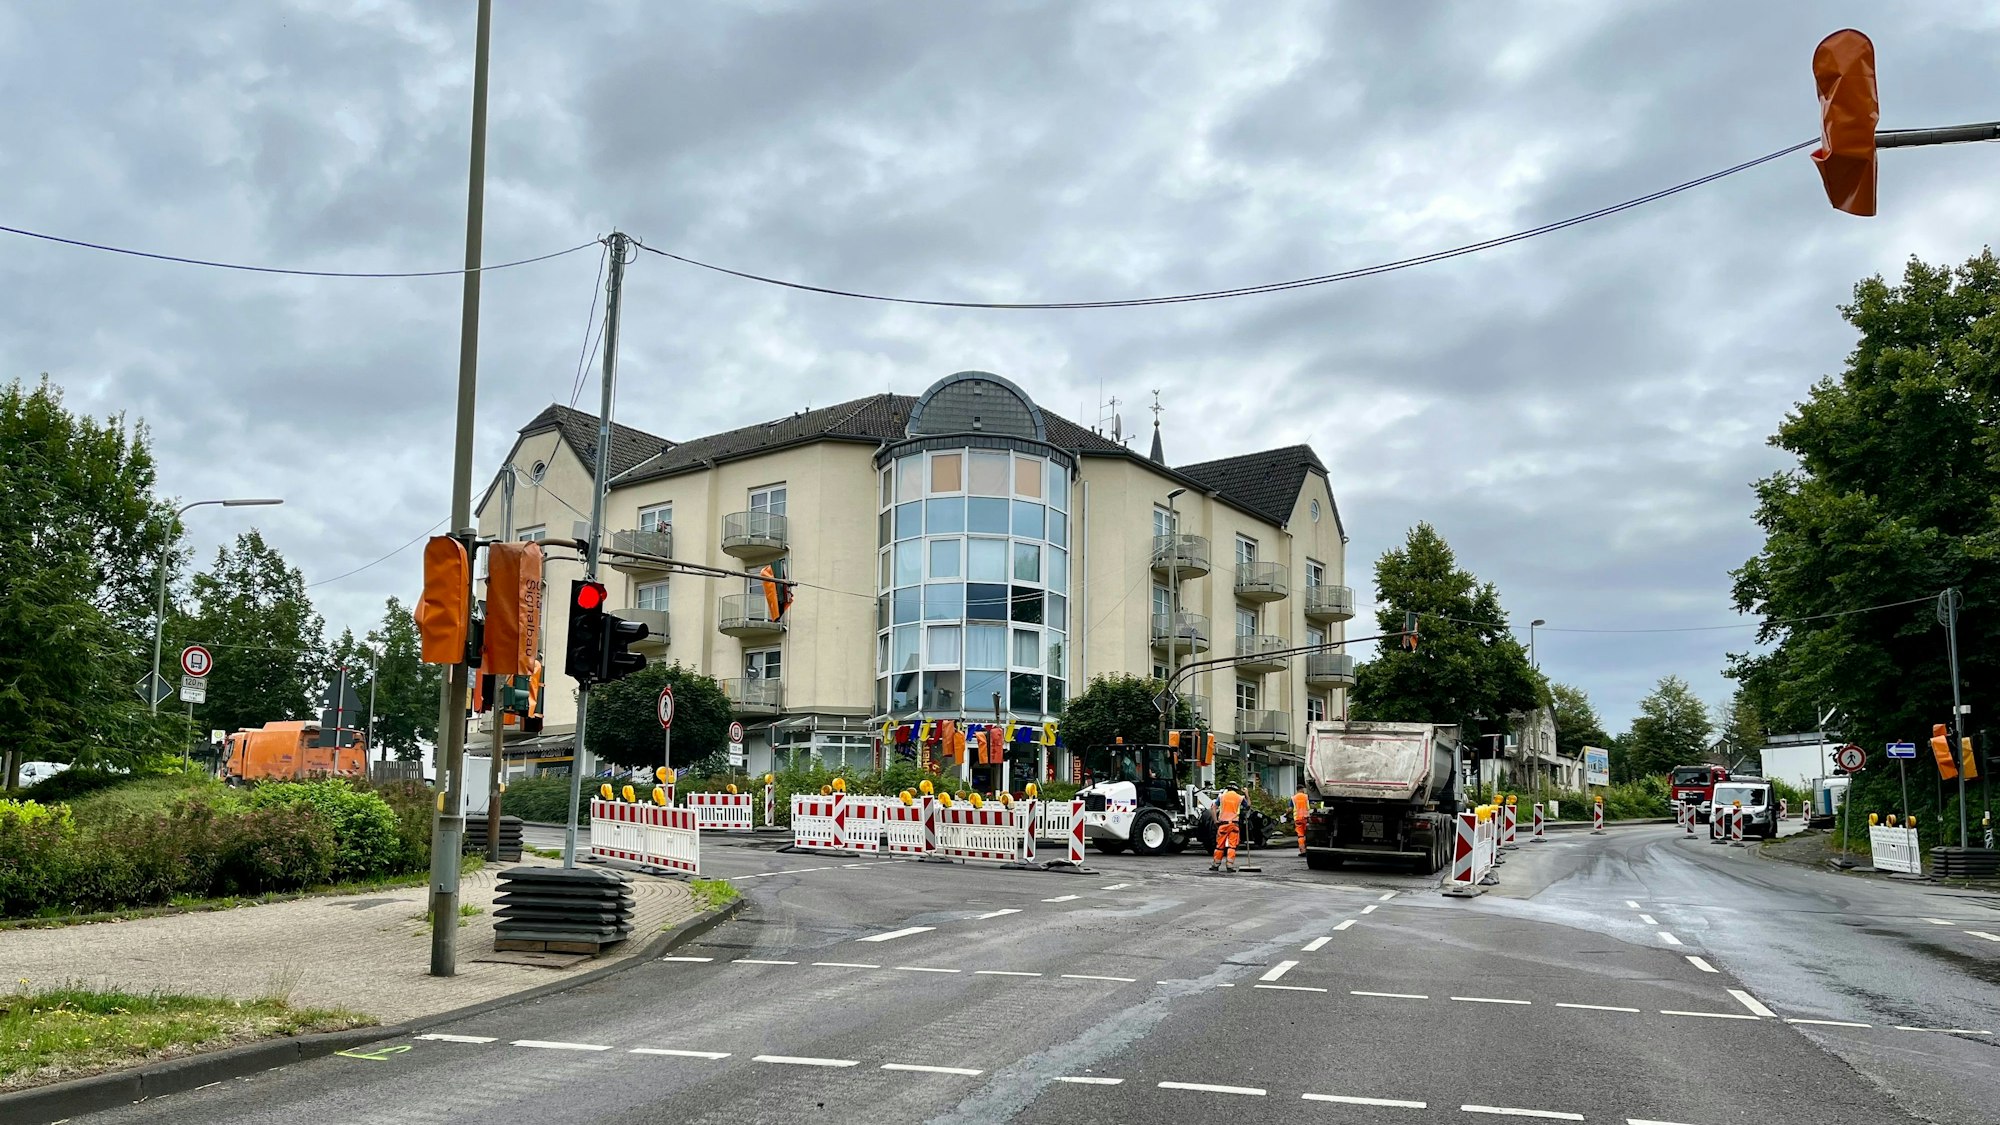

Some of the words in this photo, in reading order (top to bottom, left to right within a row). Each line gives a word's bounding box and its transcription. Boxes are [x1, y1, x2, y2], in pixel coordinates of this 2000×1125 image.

[525, 580, 536, 657] Signalbau
[185, 678, 197, 686] 120
[883, 717, 1033, 746] Califria
